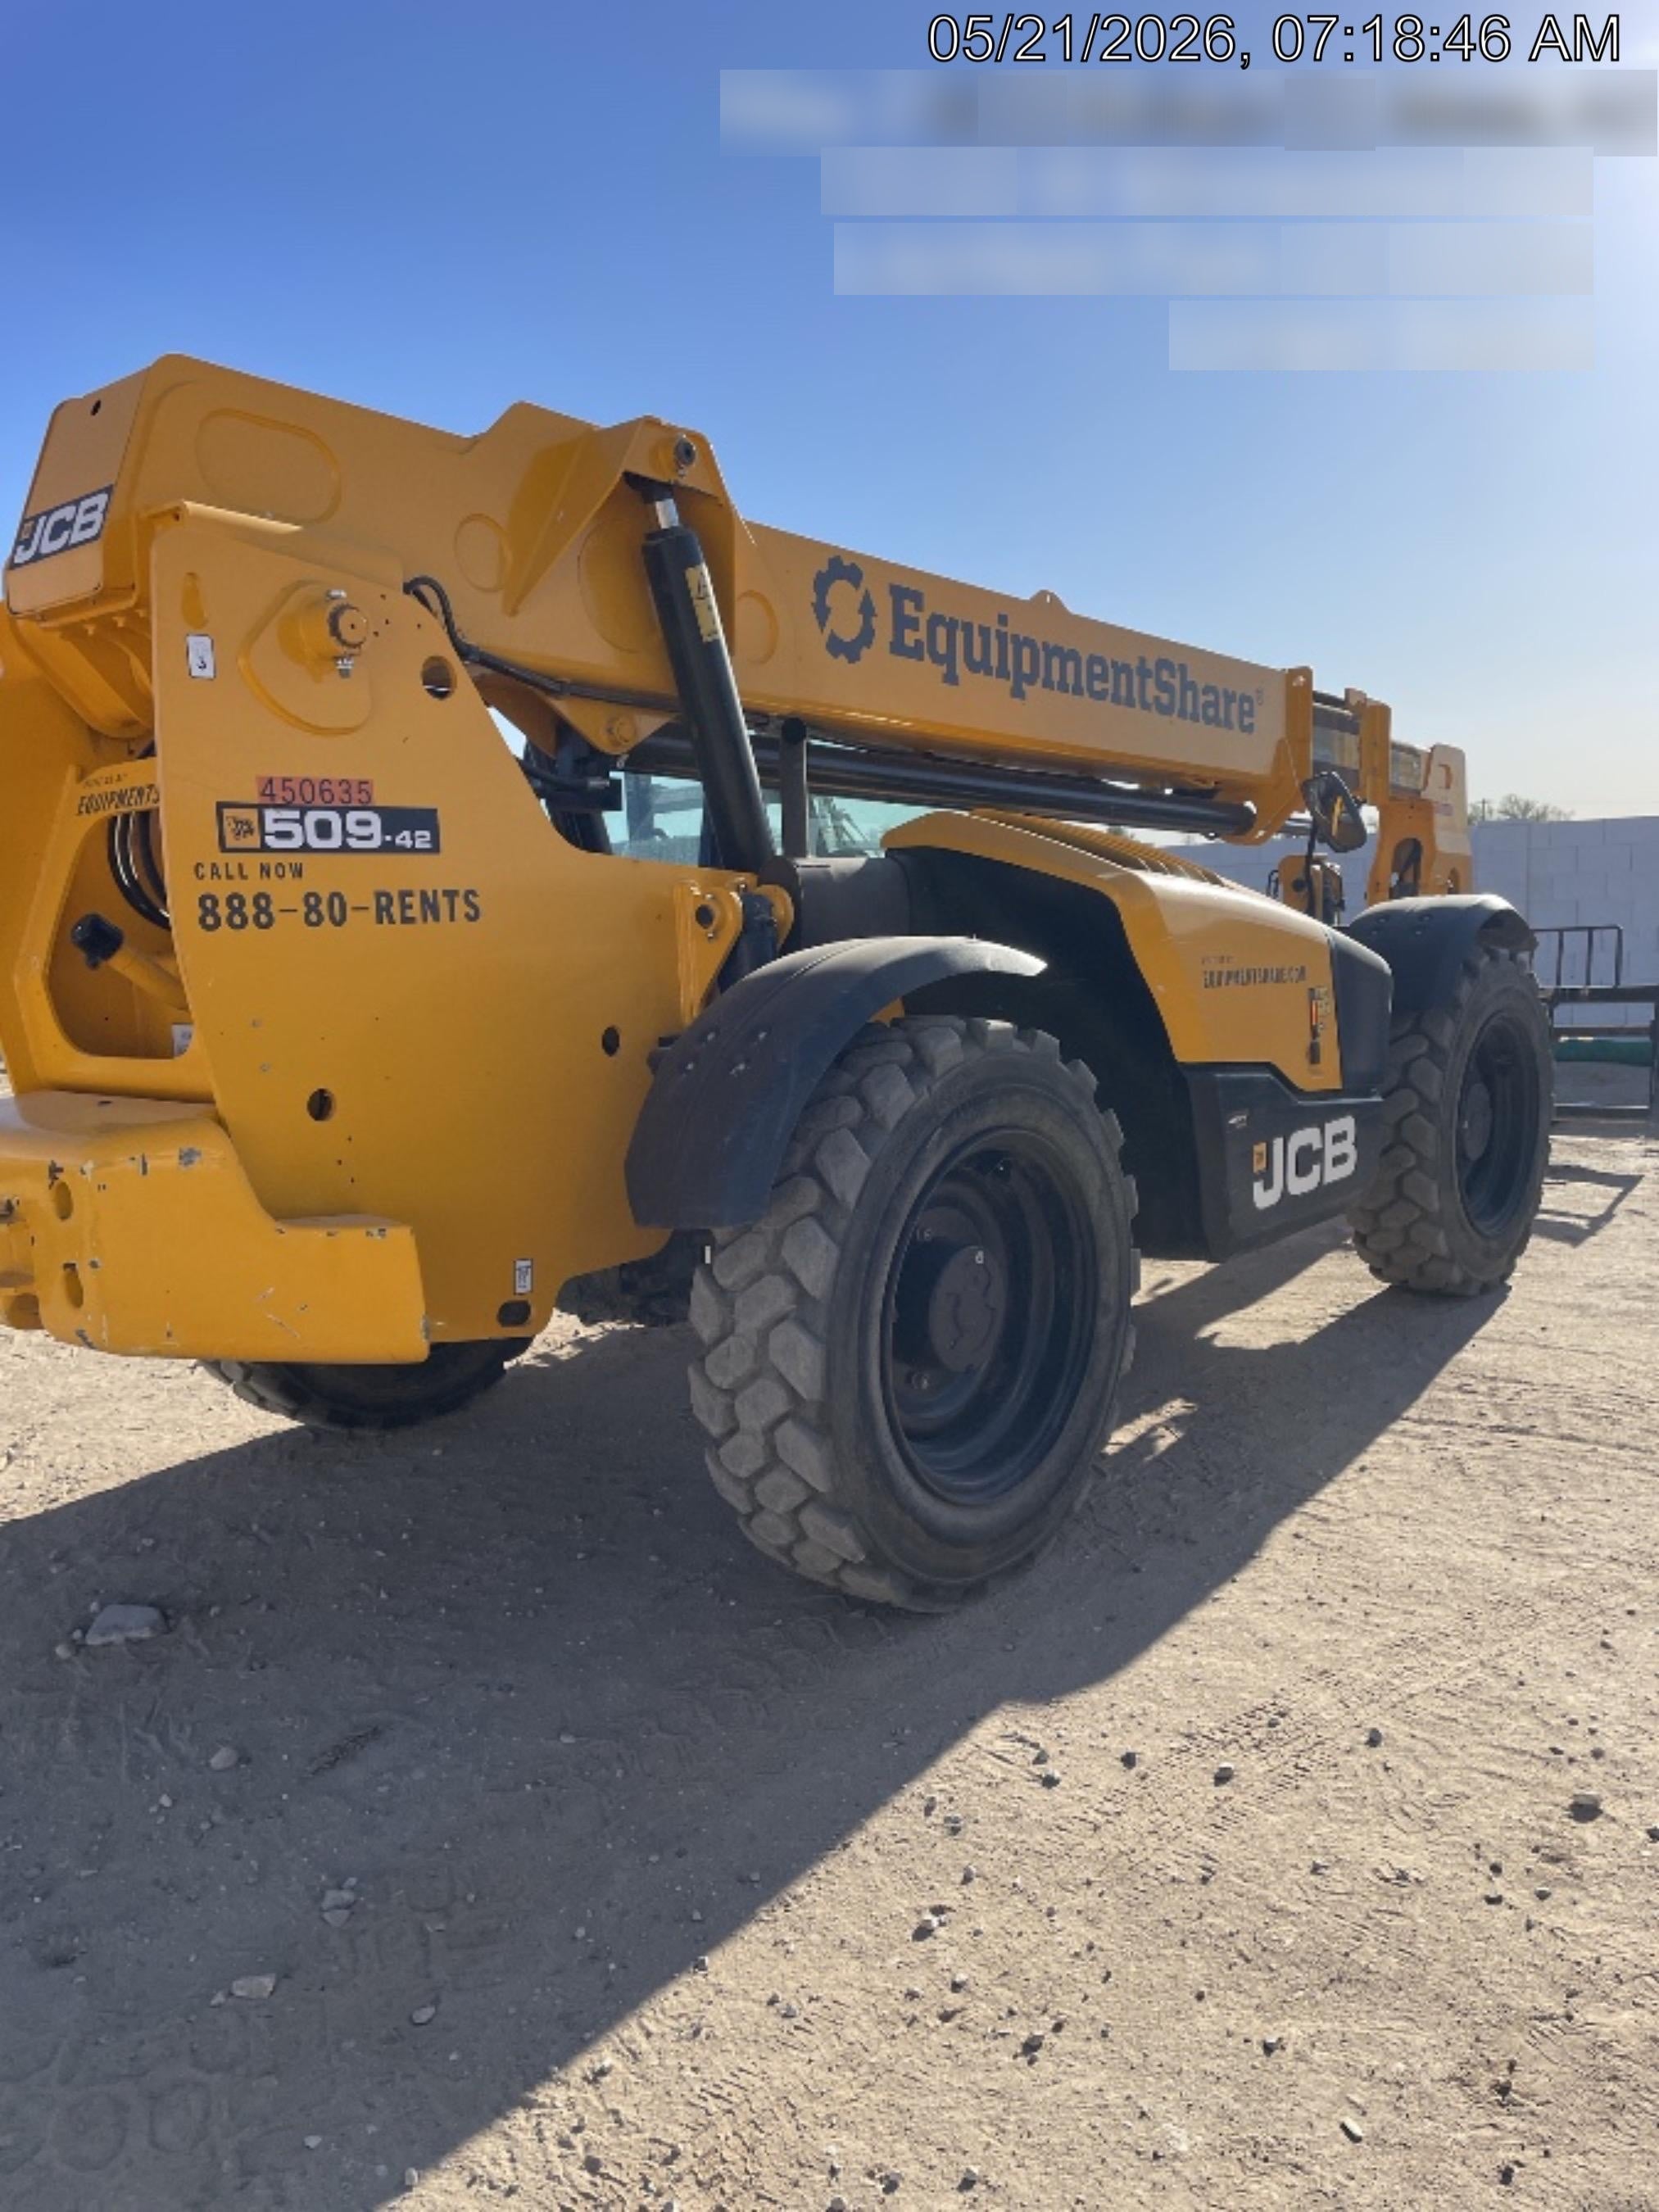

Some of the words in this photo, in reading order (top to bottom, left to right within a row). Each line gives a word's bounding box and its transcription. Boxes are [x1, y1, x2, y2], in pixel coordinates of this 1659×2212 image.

[14, 492, 109, 564] JCB
[889, 582, 1255, 734] EquipmentShare
[260, 777, 373, 805] 450635
[194, 862, 249, 881] CALL
[260, 862, 304, 879] NOW
[198, 889, 481, 931] 888-80-RENTS
[1253, 1114, 1358, 1210] JCB
